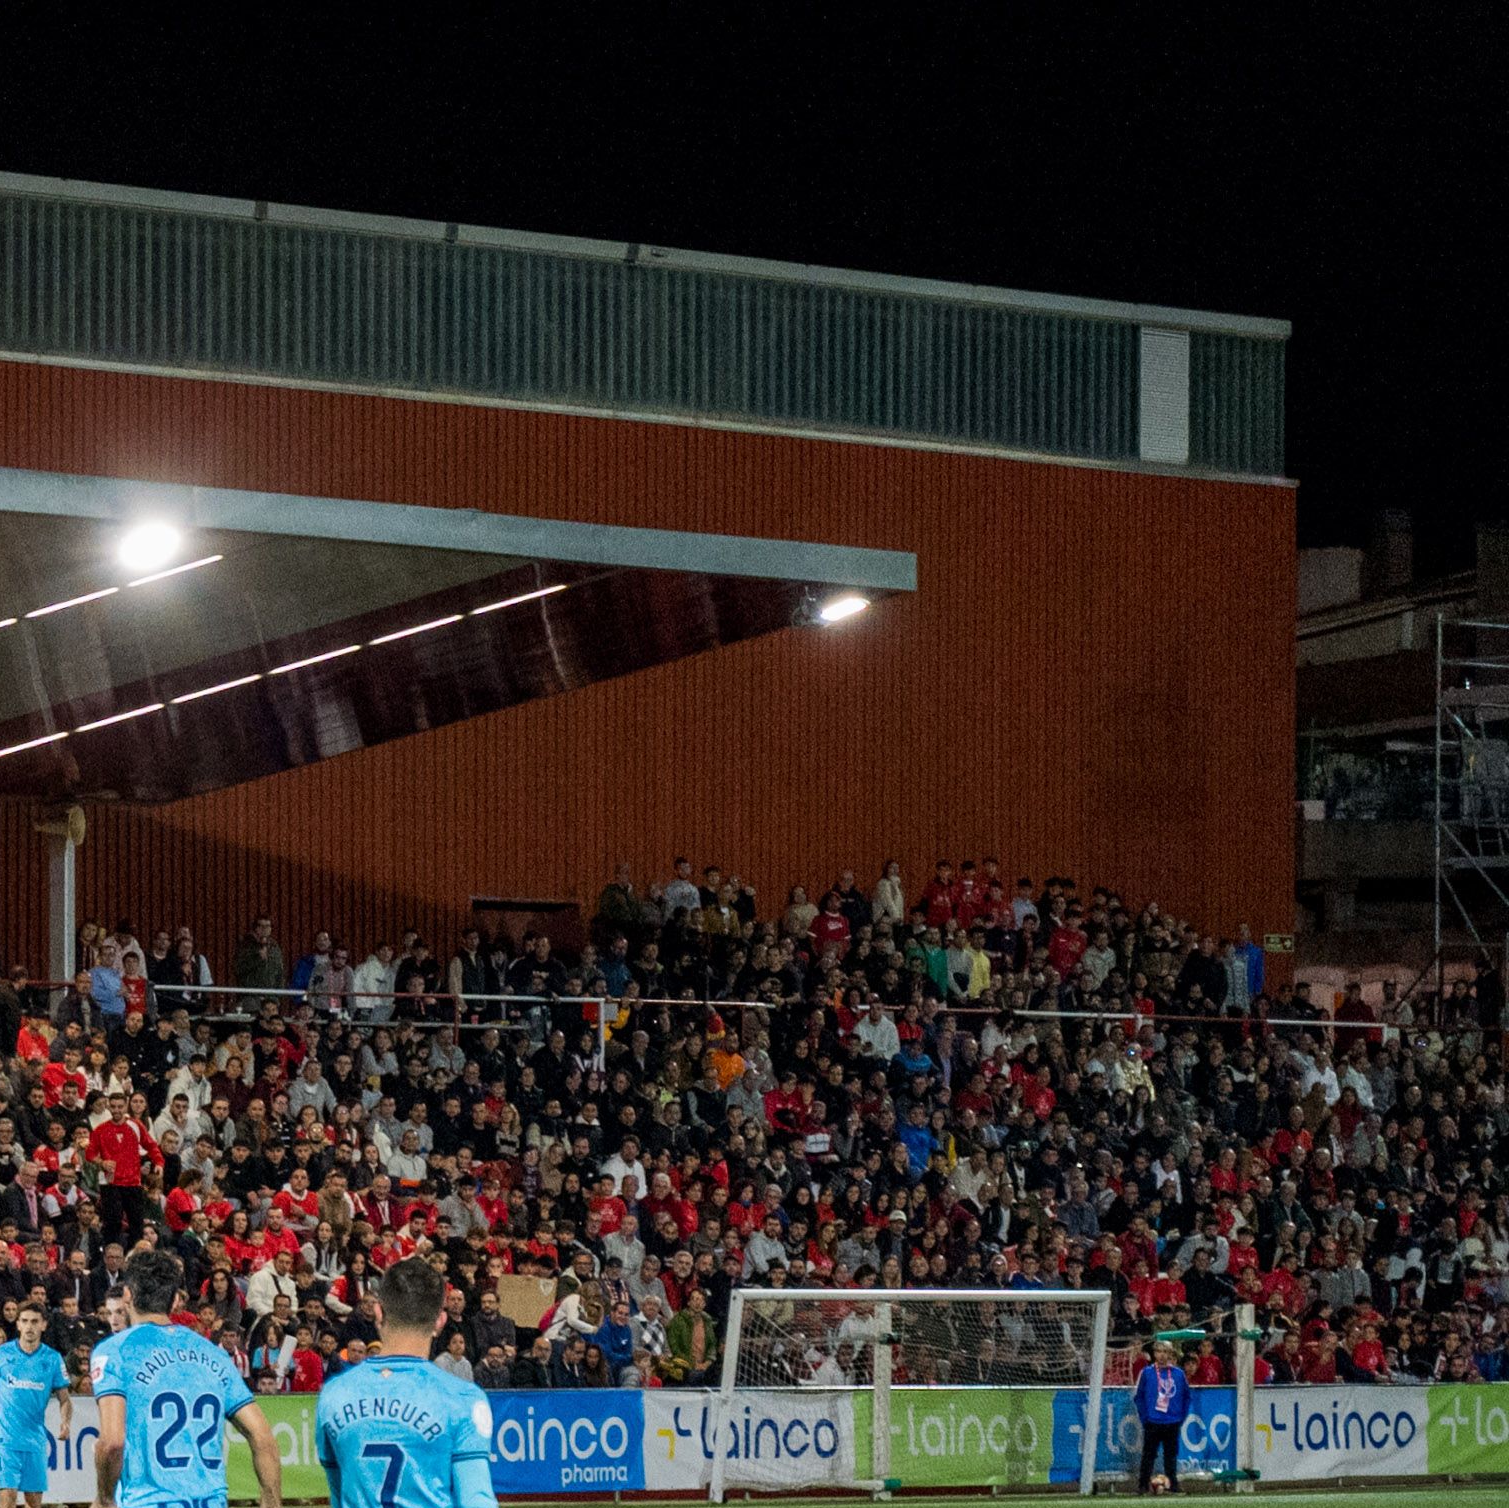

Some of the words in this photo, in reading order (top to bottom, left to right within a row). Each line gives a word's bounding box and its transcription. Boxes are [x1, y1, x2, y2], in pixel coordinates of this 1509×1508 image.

[136, 1349, 176, 1386] RAÚL
[176, 1348, 229, 1388] GARCÍA
[151, 1391, 222, 1471] 22
[324, 1397, 442, 1442] BERENGUER
[490, 1406, 629, 1463] ainco
[907, 1402, 1038, 1456] lainco
[1293, 1401, 1416, 1451] lainco
[561, 1463, 628, 1488] pharma
